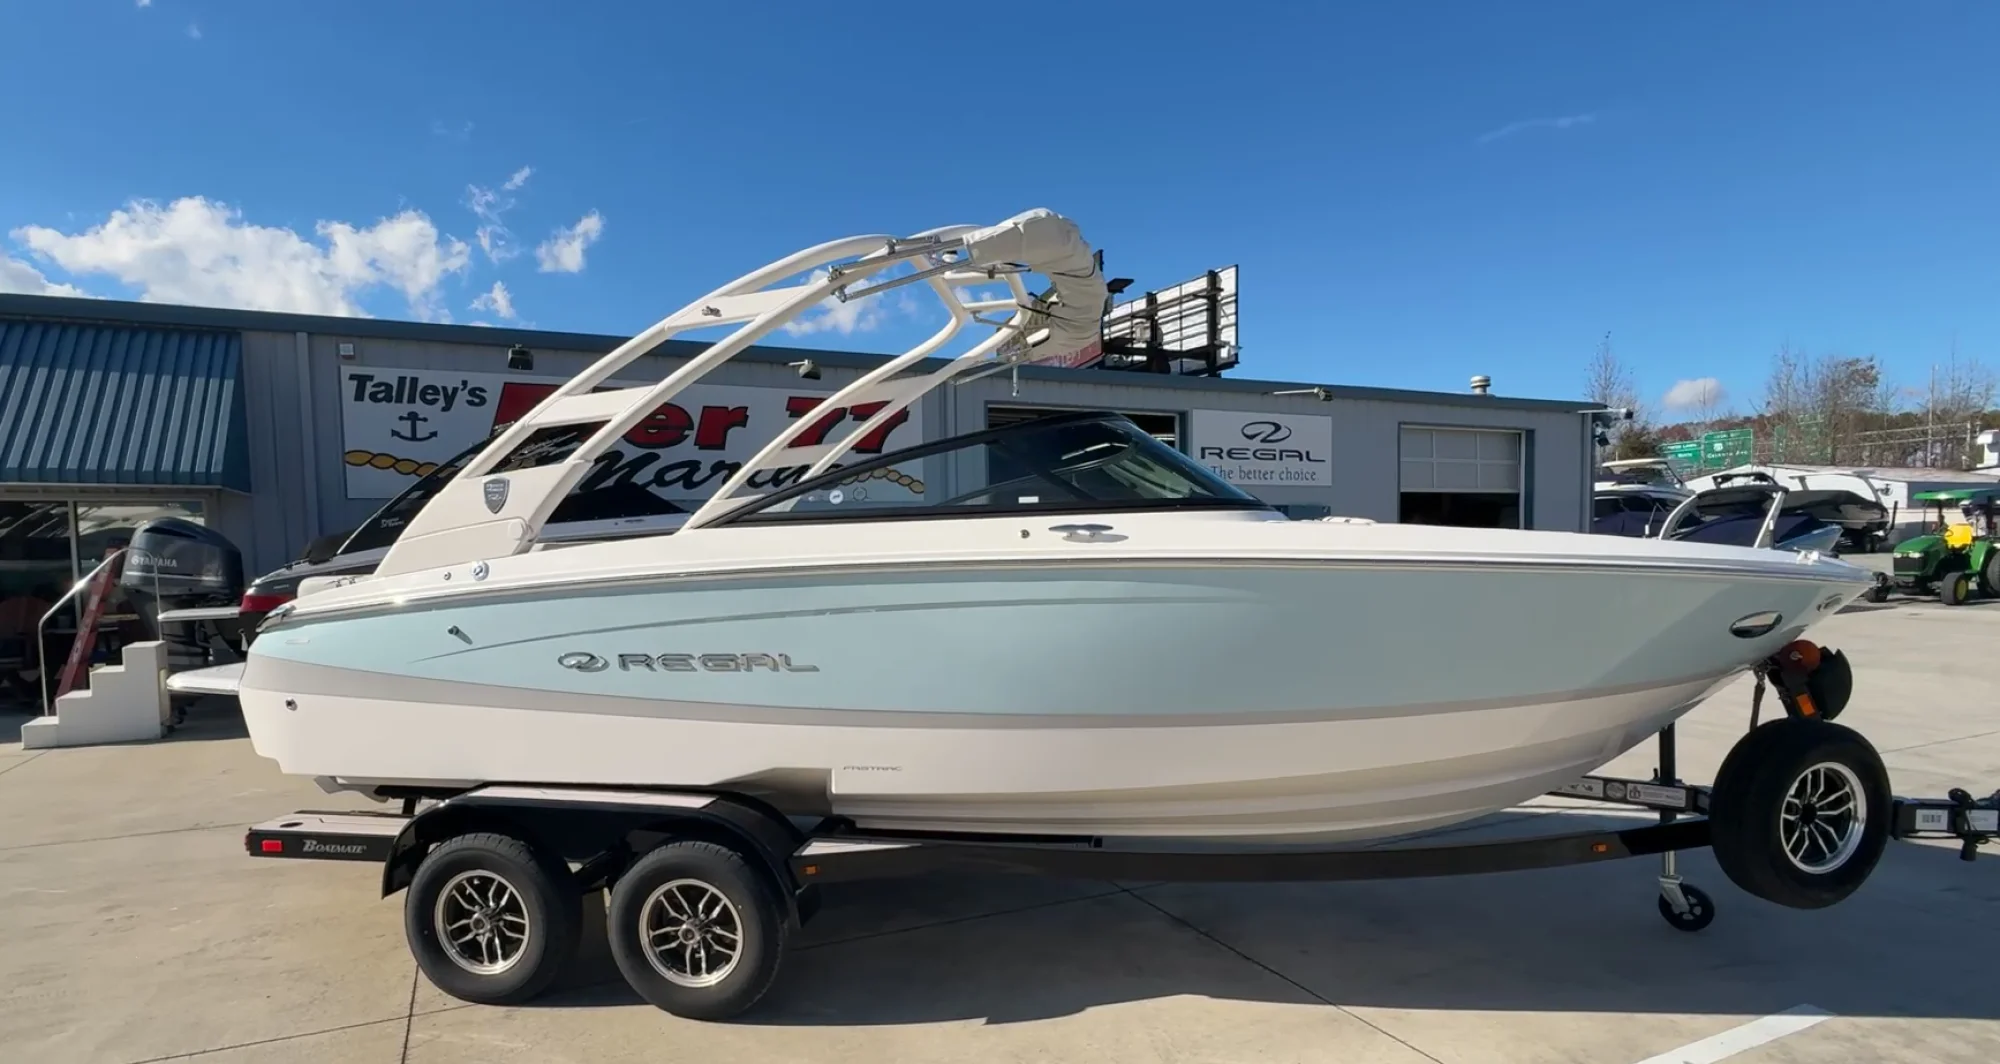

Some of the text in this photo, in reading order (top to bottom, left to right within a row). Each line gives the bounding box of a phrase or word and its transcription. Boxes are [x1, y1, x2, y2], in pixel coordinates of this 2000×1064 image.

[348, 374, 487, 412] Talley's
[786, 396, 909, 454] 77
[1200, 446, 1326, 462] REGAL
[576, 450, 844, 491] Marin
[1211, 465, 1234, 480] The
[1238, 465, 1275, 481] better
[617, 653, 820, 672] REGAL
